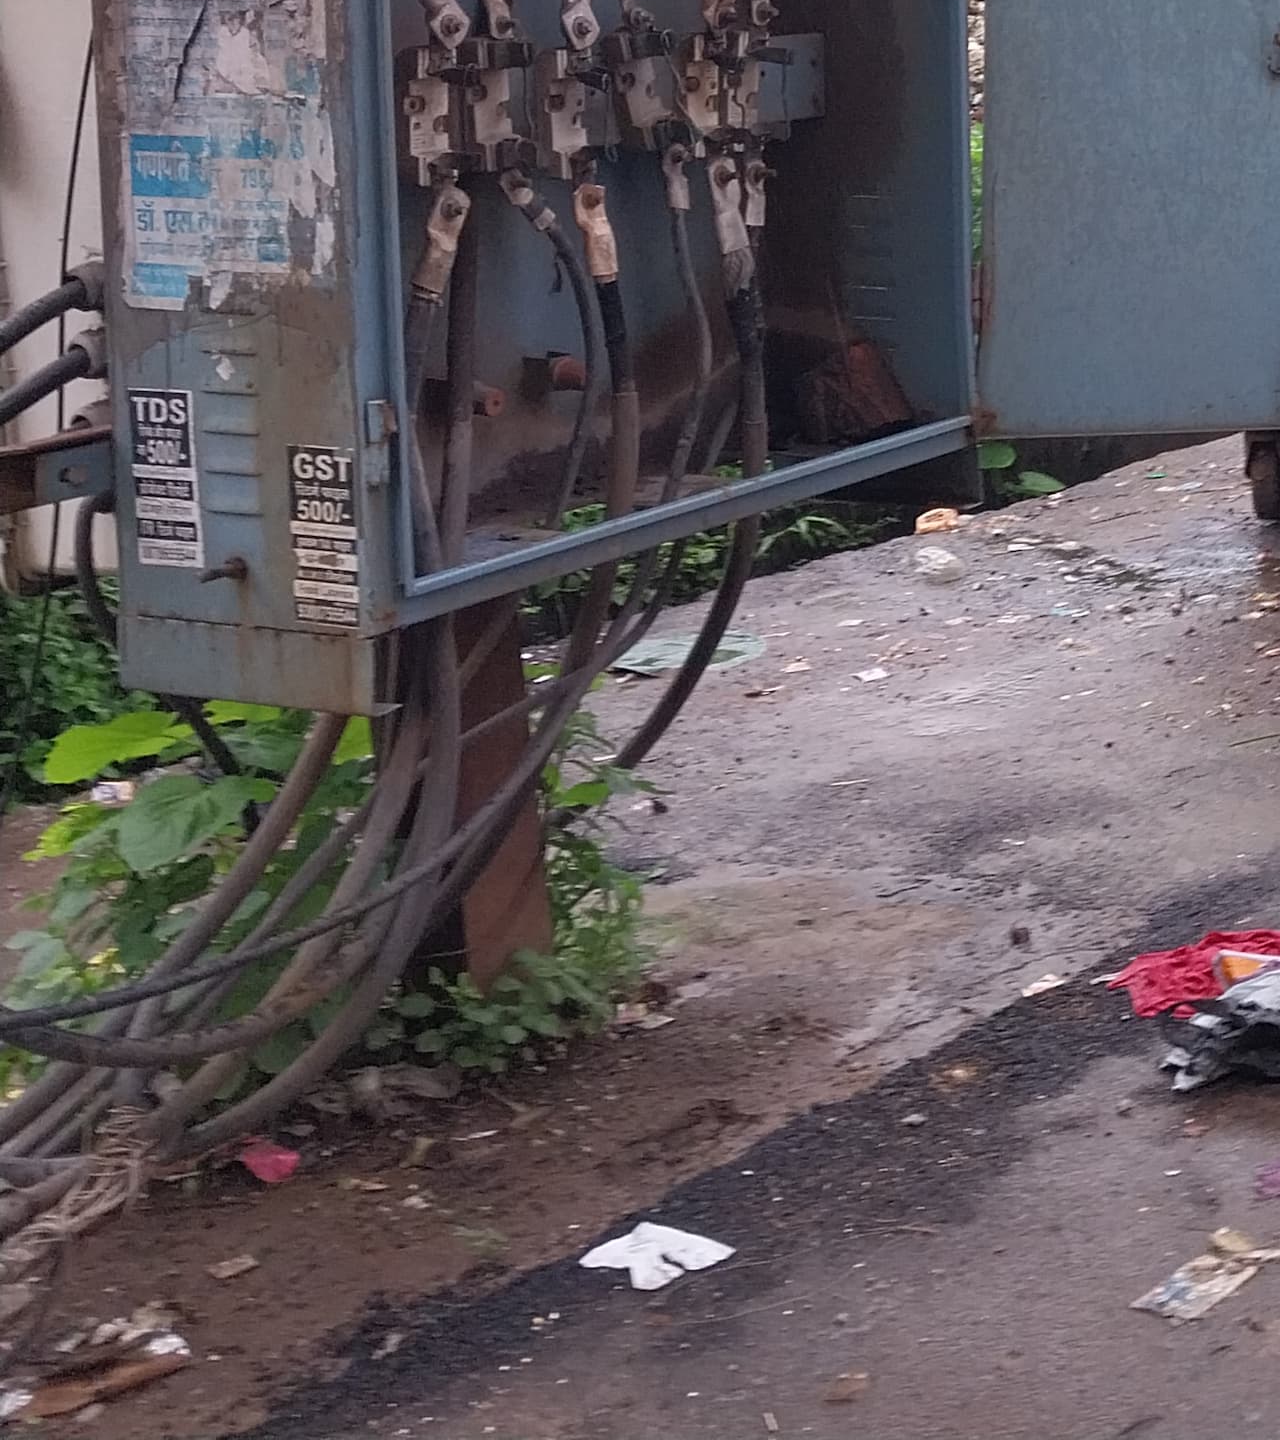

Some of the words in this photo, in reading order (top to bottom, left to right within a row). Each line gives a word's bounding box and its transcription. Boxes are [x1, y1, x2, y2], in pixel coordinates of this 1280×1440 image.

[130, 396, 187, 425] TDS
[292, 452, 353, 483] GST
[296, 499, 353, 523] 500/-
